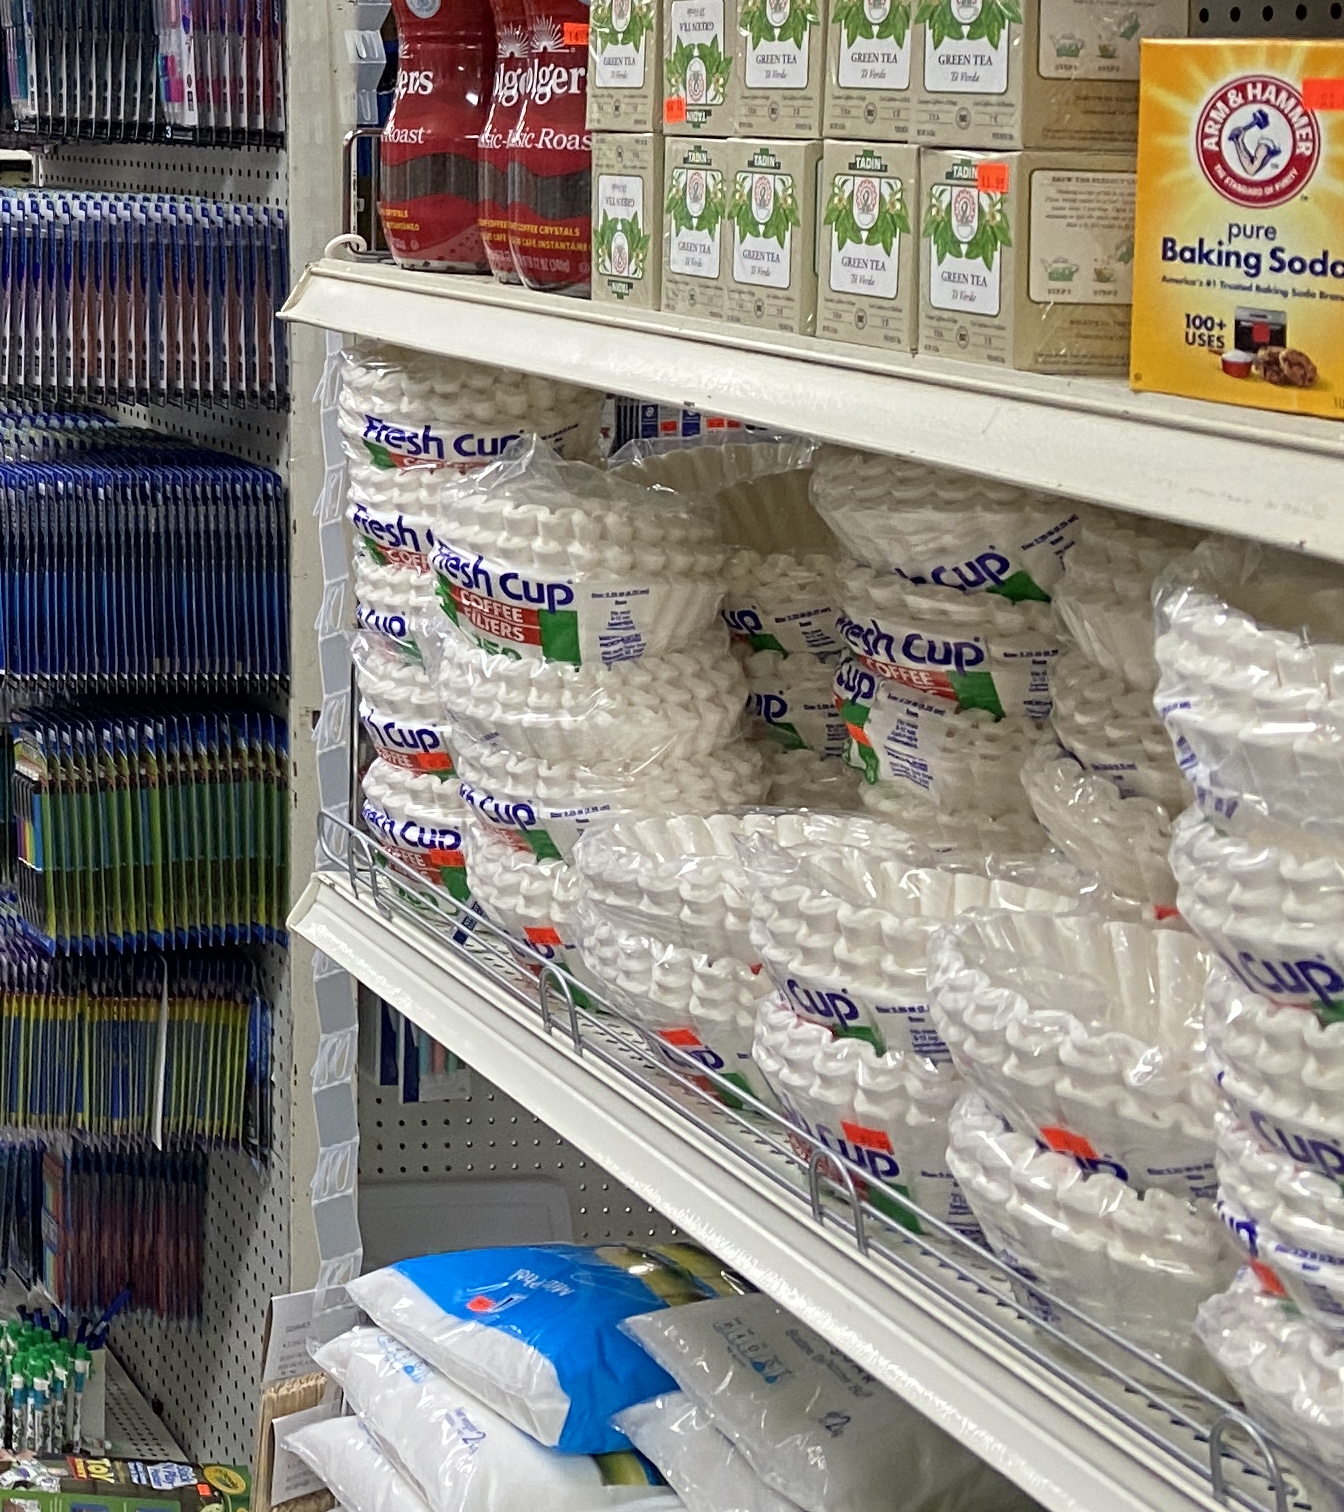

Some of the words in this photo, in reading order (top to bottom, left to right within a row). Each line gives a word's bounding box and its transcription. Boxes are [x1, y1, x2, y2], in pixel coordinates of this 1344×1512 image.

[603, 57, 620, 65] GREEN
[622, 57, 636, 65] TEA
[756, 55, 780, 64] GREEN
[782, 55, 797, 64] TEA
[851, 53, 879, 63] GREEN
[881, 53, 898, 64] TEA
[938, 54, 971, 66] GREEN
[972, 55, 993, 66] TEA
[1203, 100, 1230, 151] ARM
[1227, 89, 1245, 108] &
[1246, 82, 1313, 156] HAMMER
[688, 152, 707, 163] TADIN
[754, 155, 775, 167] TADIN
[855, 157, 881, 170] TADIN
[1224, 175, 1263, 198] STANDARD
[539, 226, 581, 237] CRYSTALS
[1228, 222, 1277, 244] pure
[678, 241, 697, 253] GREEN
[698, 243, 711, 254] TEA
[742, 249, 765, 261] GREEN
[766, 252, 781, 263] TEA
[1162, 237, 1262, 278] Baking
[1269, 246, 1344, 279] Soda
[841, 256, 868, 269] GREEN
[870, 259, 886, 271] TEA
[941, 271, 969, 284] GREEN
[971, 275, 988, 287] TEA
[1162, 275, 1204, 287] America's
[1206, 279, 1217, 288] #1
[1220, 281, 1253, 292] Trusted
[1256, 284, 1289, 299] Baking
[1292, 288, 1317, 299] Soda
[1185, 313, 1227, 332] 100+
[1185, 331, 1225, 349] USES
[363, 414, 444, 459] Fresh
[353, 502, 420, 552] Fresh
[431, 537, 493, 598] Fresh
[499, 571, 575, 615] Cup
[931, 551, 1010, 591] Cup
[461, 590, 524, 624] COFFEE
[464, 606, 525, 642] FILTERS
[835, 610, 896, 664] Fresh
[902, 633, 985, 676] Cup
[837, 662, 876, 705] Cup
[866, 659, 933, 686] COFFEE
[384, 722, 440, 753] Cup
[480, 796, 536, 830] Cup
[401, 820, 462, 851] Cup
[1238, 952, 1344, 1009] Cup
[787, 979, 859, 1031] Cup
[1250, 1110, 1344, 1179] Cup
